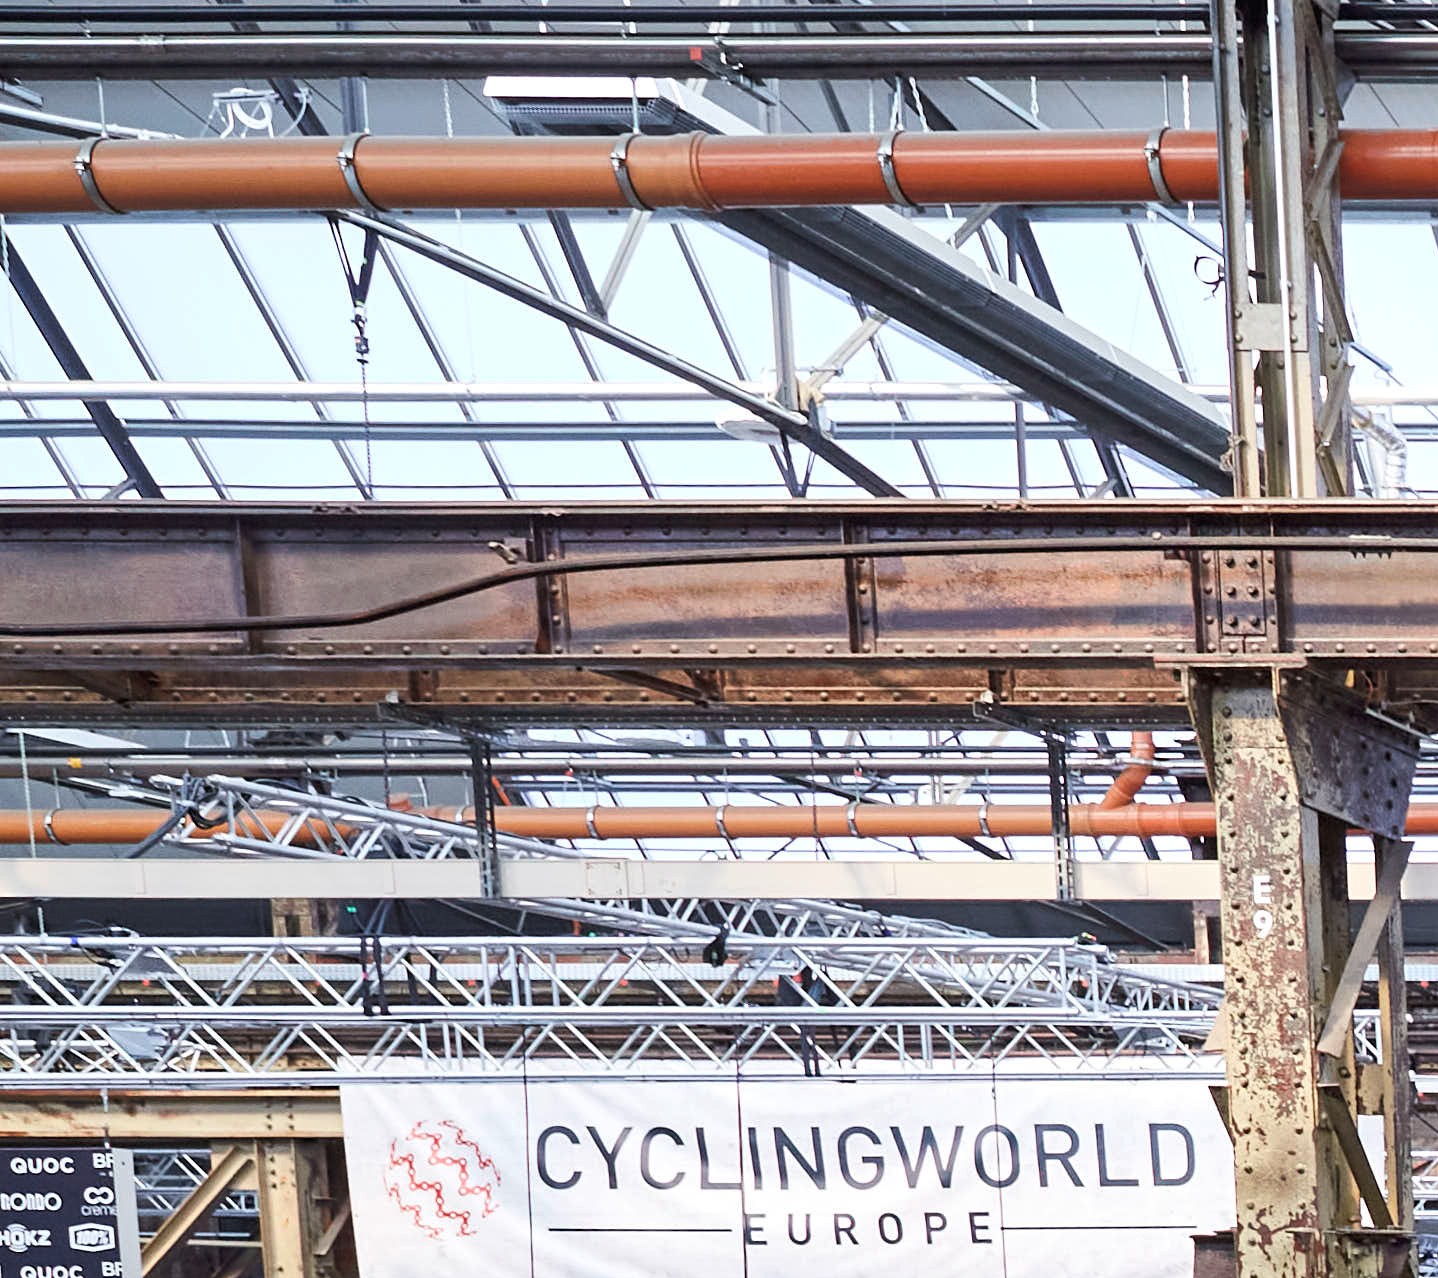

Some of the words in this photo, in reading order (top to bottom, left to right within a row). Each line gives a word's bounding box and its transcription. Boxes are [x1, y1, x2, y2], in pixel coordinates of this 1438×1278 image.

[10, 1157, 75, 1174] QUOC
[536, 1123, 1196, 1191] CYCLINGWORLD
[0, 1229, 52, 1247] HOKZ
[745, 1210, 993, 1247] EUROPE
